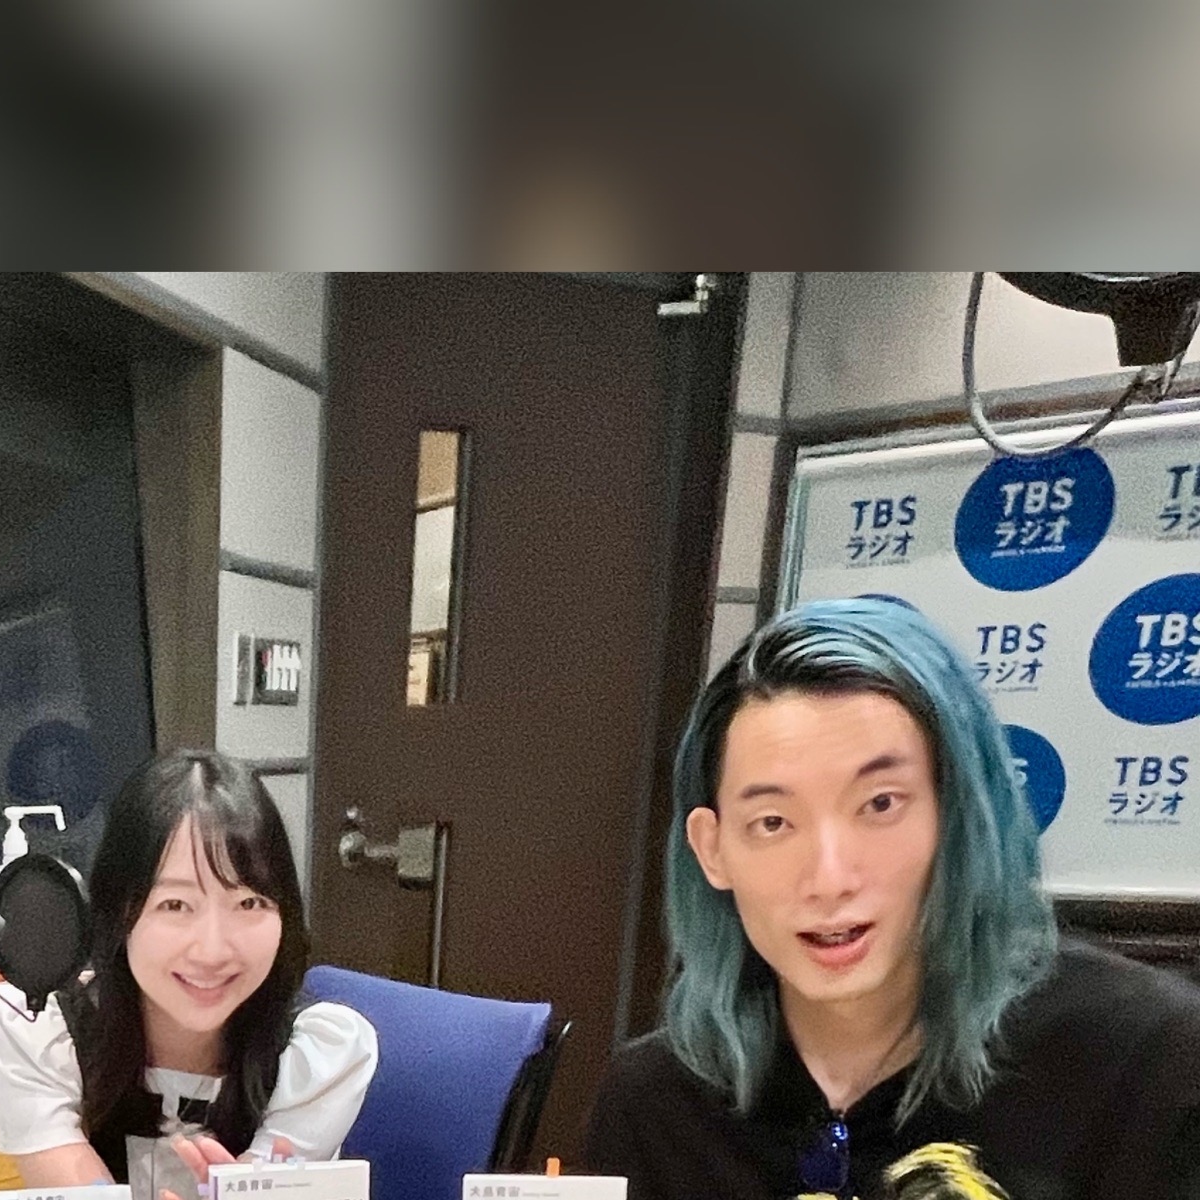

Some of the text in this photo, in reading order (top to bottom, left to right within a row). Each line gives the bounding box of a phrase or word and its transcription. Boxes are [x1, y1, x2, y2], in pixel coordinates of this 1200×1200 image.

[1001, 477, 1076, 516] TBS
[851, 496, 917, 531] TBS
[847, 530, 915, 560] ラジオ
[995, 516, 1070, 548] ラジオ
[977, 622, 1047, 655] TBS
[975, 658, 1043, 683] ラジオ
[1115, 756, 1189, 787] TBS
[1109, 792, 1185, 816] ラジオ
